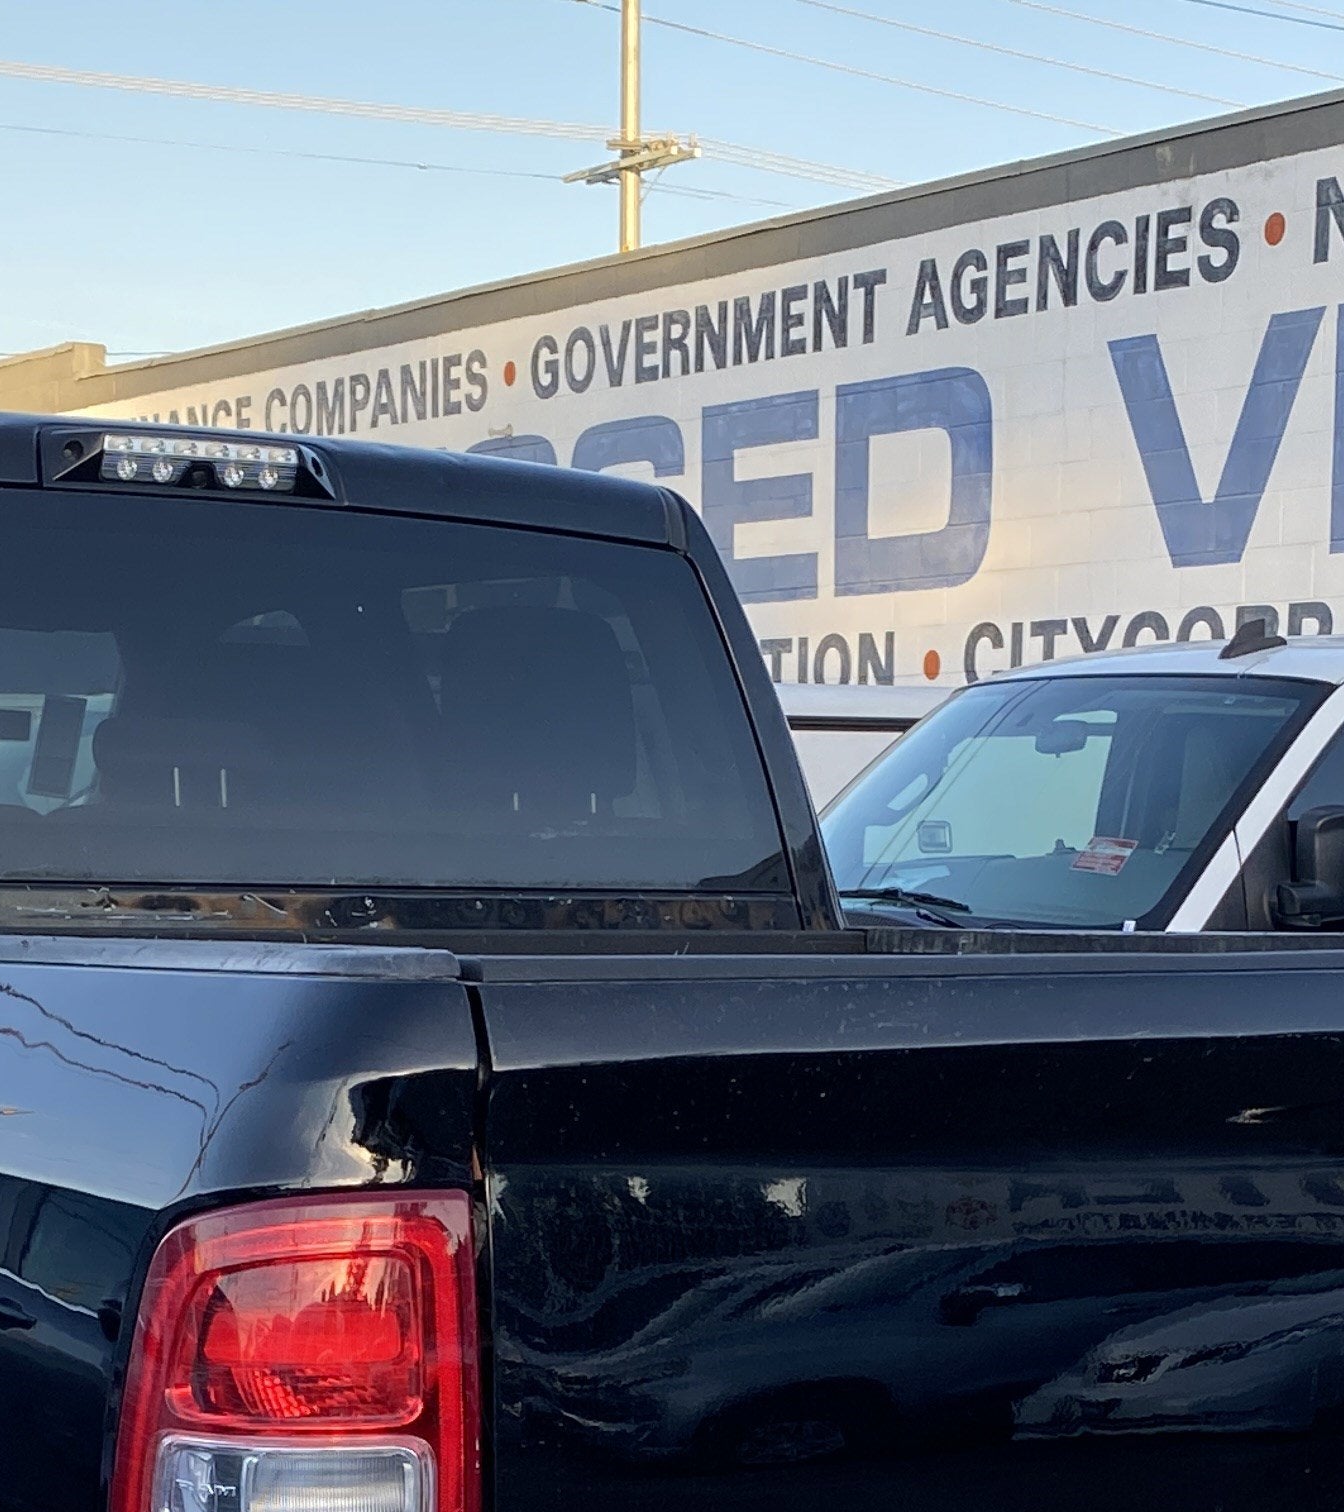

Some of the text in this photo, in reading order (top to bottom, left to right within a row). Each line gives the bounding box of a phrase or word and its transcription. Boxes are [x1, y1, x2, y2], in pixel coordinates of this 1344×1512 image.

[265, 349, 488, 436] COMPANIES
[530, 268, 887, 400] GOVERNMENT
[905, 198, 1241, 336] AGENCIES
